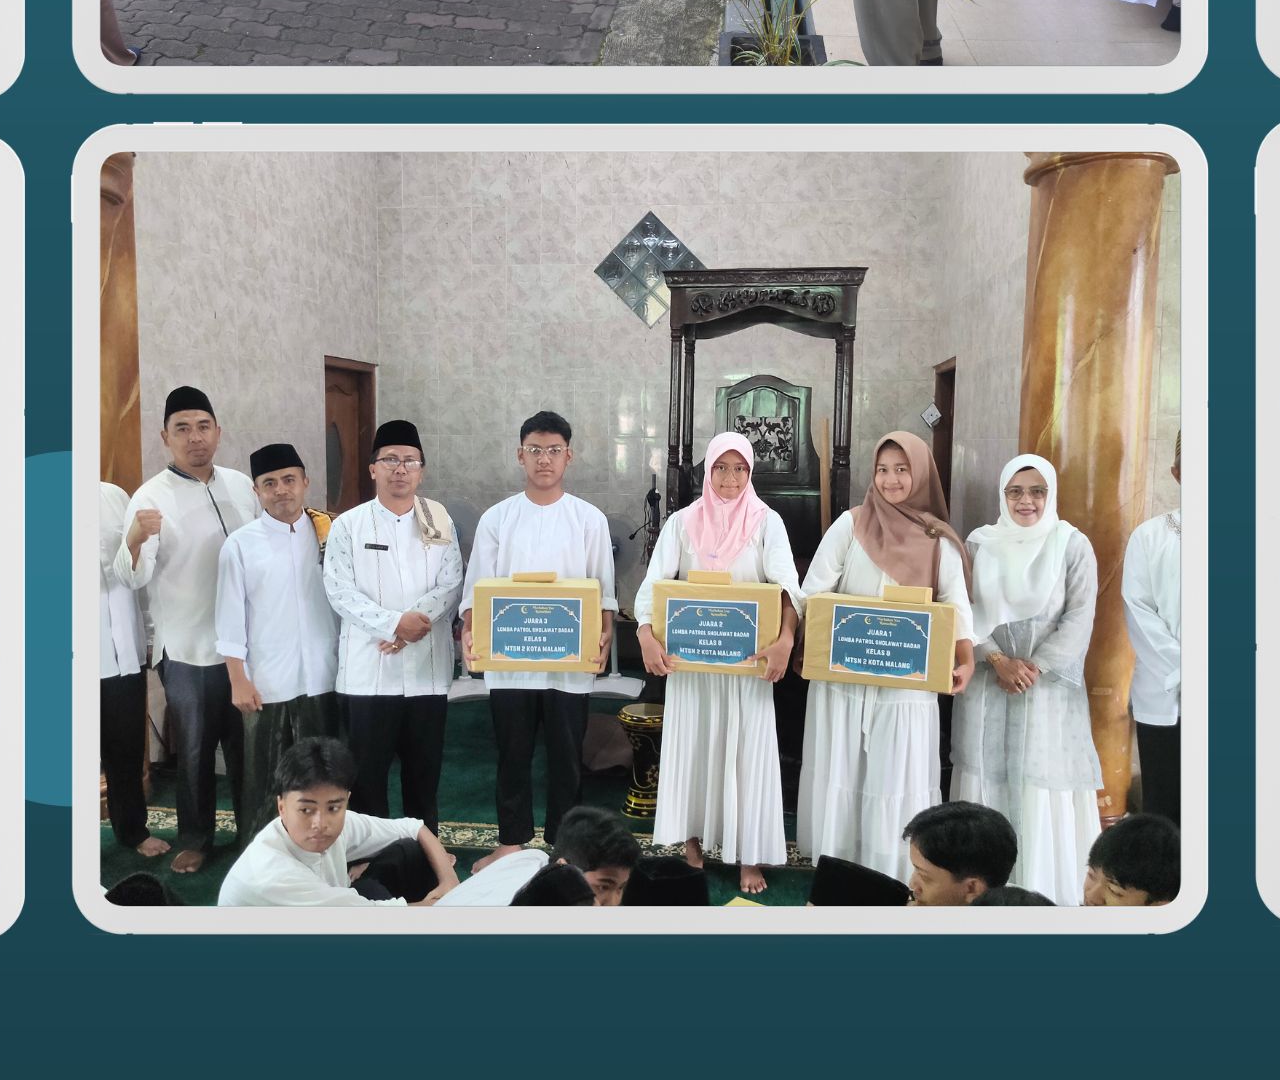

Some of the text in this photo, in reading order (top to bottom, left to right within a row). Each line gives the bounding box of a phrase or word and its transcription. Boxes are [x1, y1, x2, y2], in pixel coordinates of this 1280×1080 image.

[867, 629, 888, 637] JUARA
[868, 658, 884, 666] KOTA
[885, 660, 910, 669] MALANG
